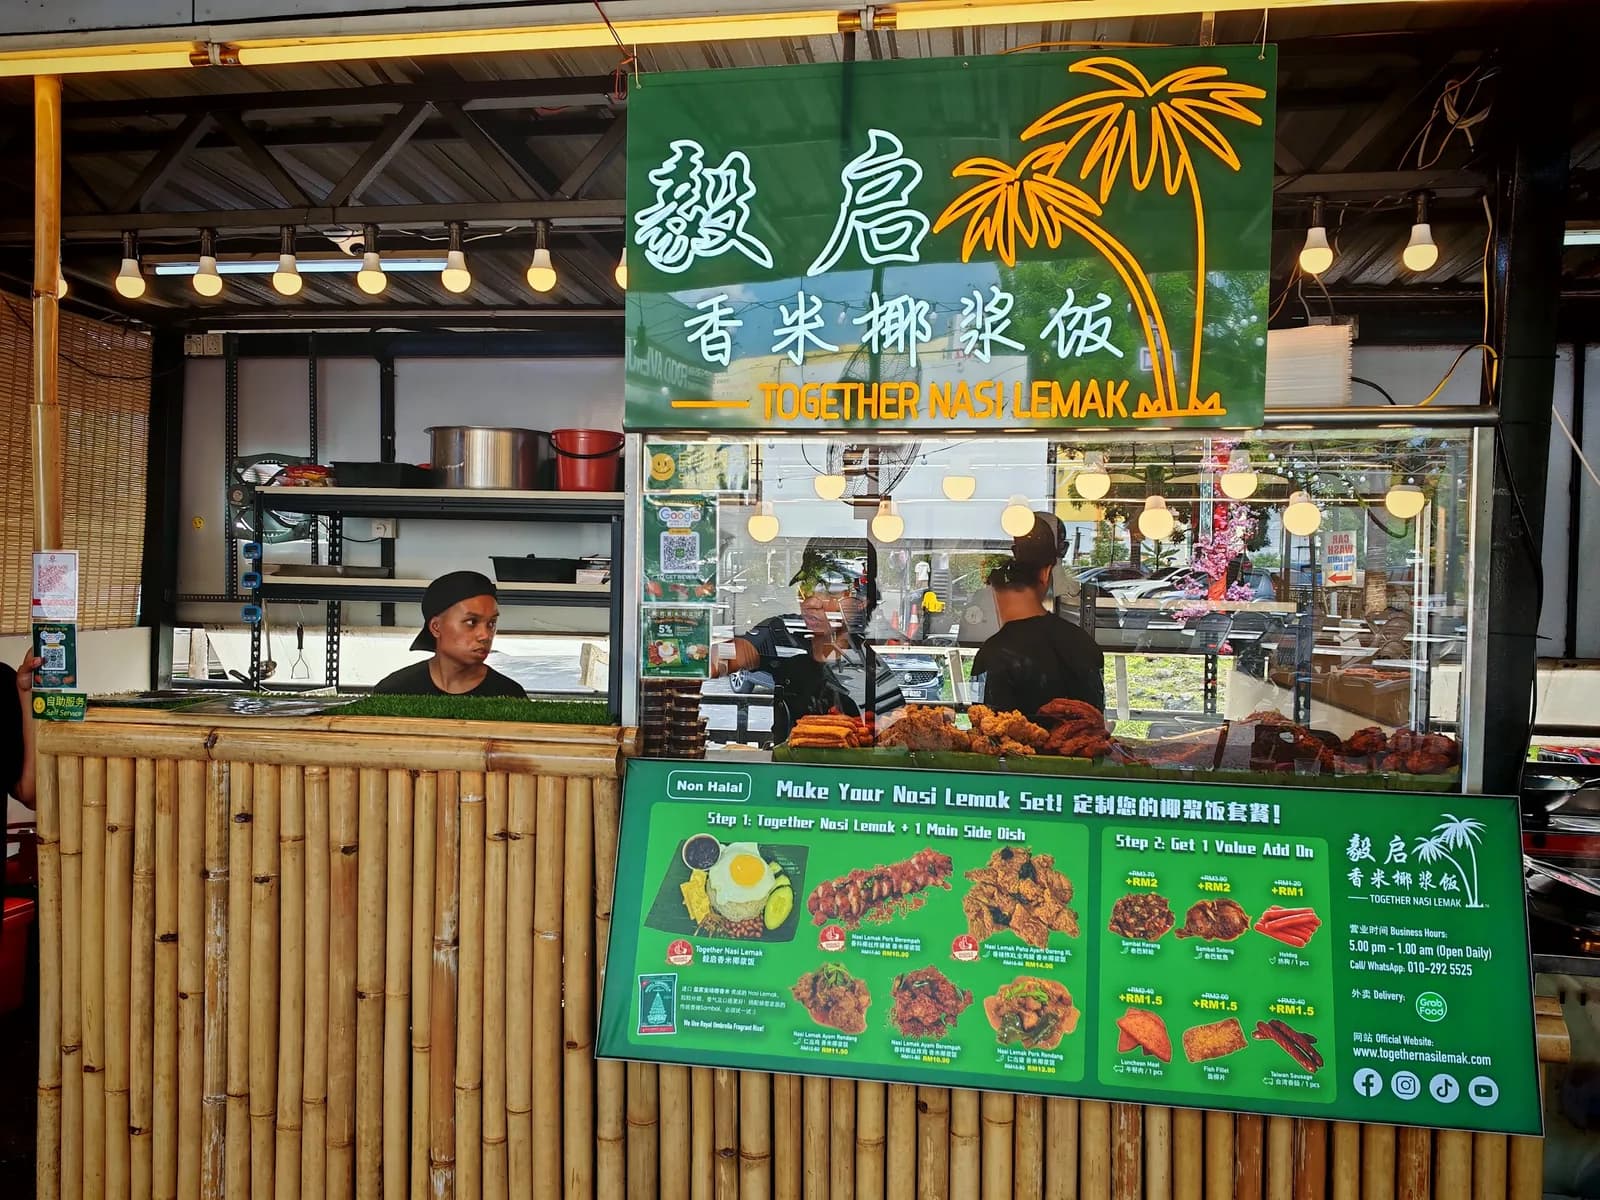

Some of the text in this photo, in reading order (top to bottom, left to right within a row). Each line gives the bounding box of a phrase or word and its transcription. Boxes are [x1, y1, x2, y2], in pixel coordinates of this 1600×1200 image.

[684, 285, 1123, 369] 香米椰浆饭
[758, 379, 1130, 421] TOGETHER NASI LEMAK
[658, 625, 672, 633] 5%
[47, 696, 84, 707] 自助服务
[47, 708, 58, 716] Self
[677, 780, 742, 793] Non Halal
[776, 780, 829, 800] Make
[839, 783, 884, 802] Your
[893, 785, 937, 805] Nasi
[945, 788, 1010, 809] Lemak
[1020, 792, 1063, 812] Set!
[708, 812, 736, 827] Step
[743, 814, 751, 826] 1:
[758, 814, 815, 829] Together
[820, 817, 848, 831] Nasi
[854, 819, 895, 833] Lemak
[915, 823, 921, 834] 1
[927, 823, 958, 837] Main
[964, 825, 992, 839] Side
[997, 827, 1026, 841] Dish
[1115, 834, 1314, 858] Step 2: Get 1 Value Add On
[1346, 833, 1408, 865] 毅启
[1125, 877, 1158, 888] +RM2
[1347, 867, 1461, 892] 香米椰浆饭
[1198, 882, 1231, 893] +RM2
[1272, 886, 1304, 897] +RM1
[1370, 894, 1461, 908] TOGETHER NASI LEMAK
[1350, 924, 1448, 939] 营业时间 Business Hours:
[696, 945, 763, 956] Together Nasi Lemak
[1349, 940, 1369, 952] 5.00
[1371, 943, 1386, 955] pm
[1397, 943, 1417, 955] 1.00
[1419, 945, 1434, 956] am
[1436, 944, 1463, 959] (Open
[1466, 946, 1492, 961] Daily)
[1367, 961, 1405, 974] WhatsApp:
[1408, 961, 1447, 975] 010-292
[1450, 964, 1472, 976] 5525
[1119, 994, 1163, 1005] +RM1.5
[1352, 989, 1406, 1003] 外卖 Delivery:
[1193, 999, 1238, 1011] +RM1.5
[1420, 999, 1443, 1007] Grab
[1269, 1004, 1315, 1016] +RM1.5
[1419, 1007, 1444, 1016] Food
[1353, 1032, 1434, 1047] 网站 Official Website:
[1120, 1059, 1146, 1067] Luncheon
[1353, 1047, 1492, 1066] www.togethernasilemak.com
